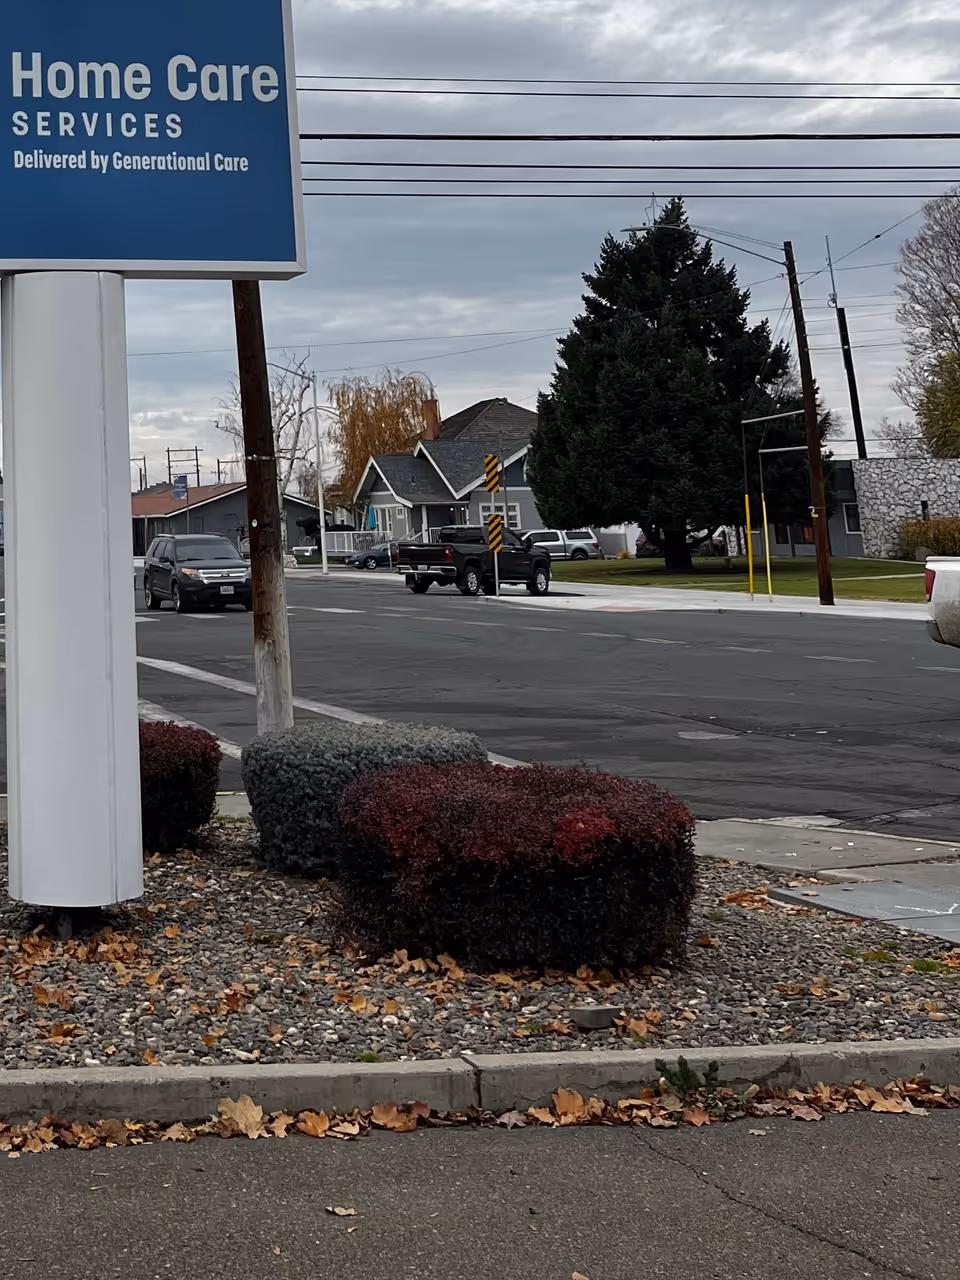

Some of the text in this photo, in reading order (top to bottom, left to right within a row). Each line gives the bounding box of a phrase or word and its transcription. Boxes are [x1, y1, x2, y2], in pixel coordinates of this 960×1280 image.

[12, 51, 279, 102] Home Care
[12, 110, 182, 138] SERVICES
[14, 149, 249, 174] Delivered by Generational Care
